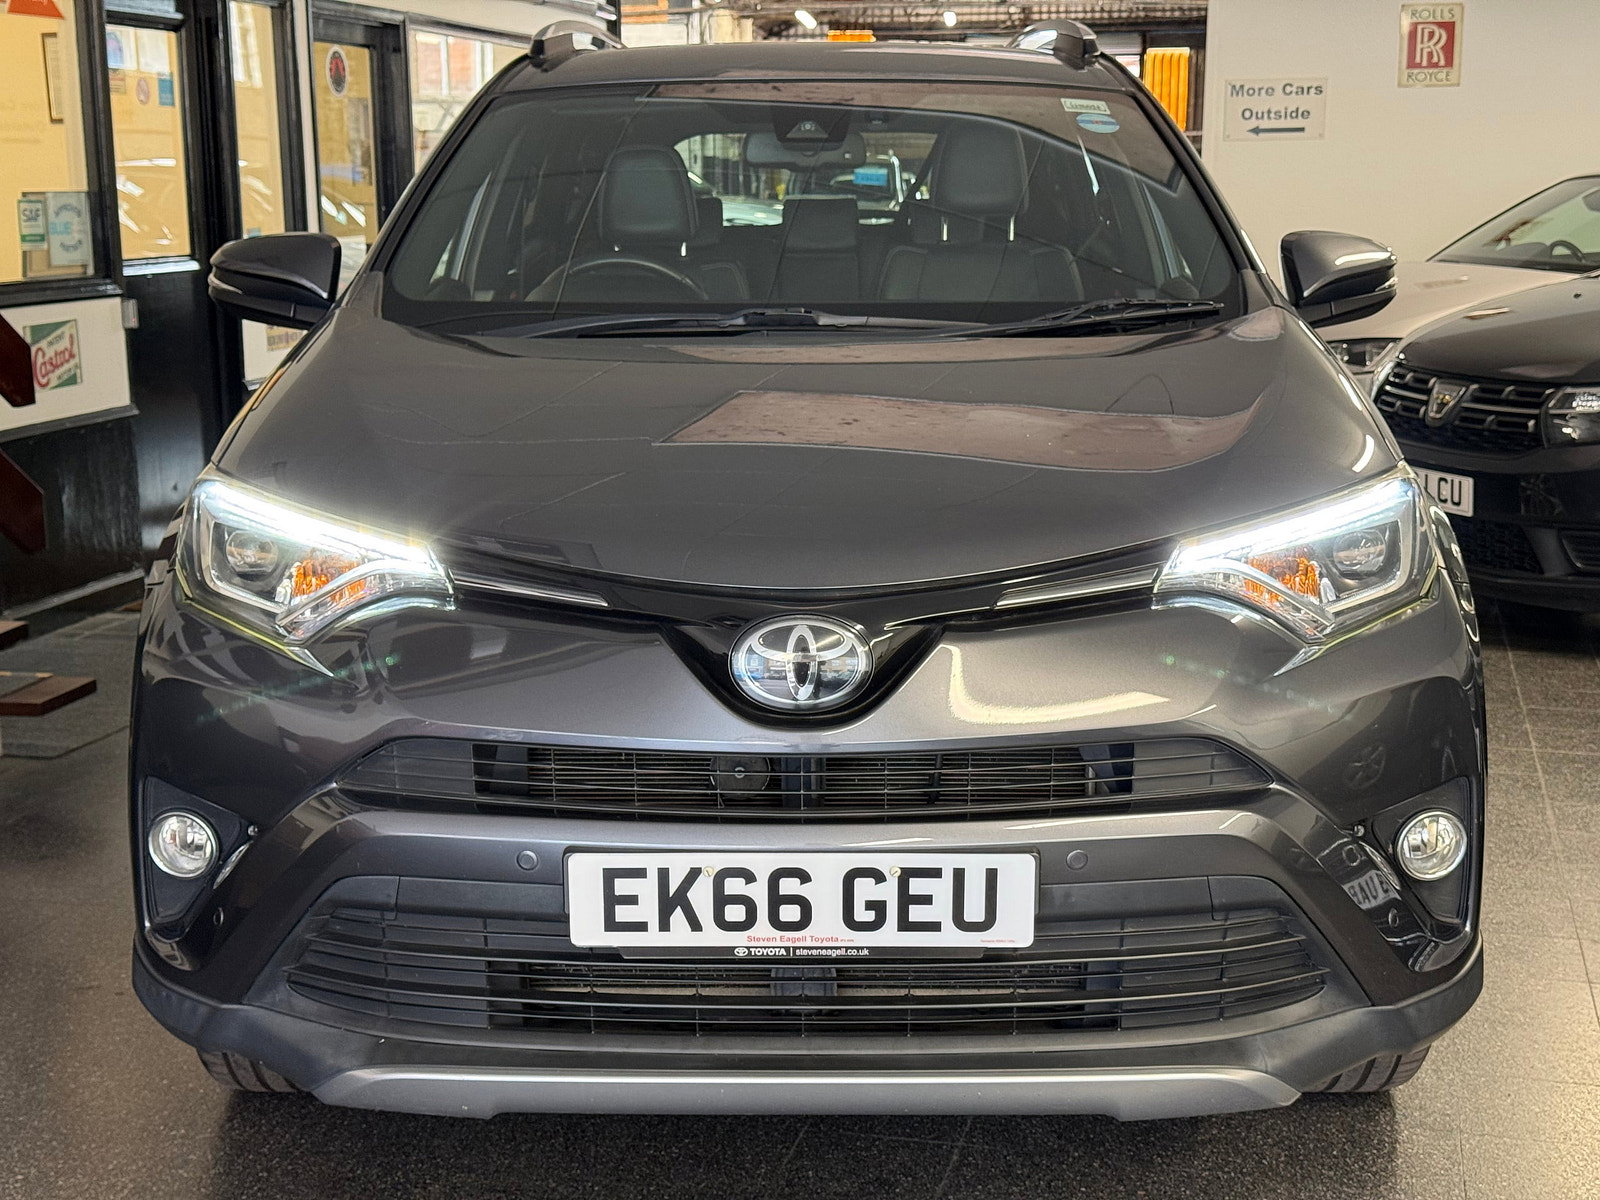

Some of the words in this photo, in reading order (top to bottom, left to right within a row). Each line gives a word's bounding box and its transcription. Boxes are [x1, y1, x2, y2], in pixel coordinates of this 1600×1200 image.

[1410, 8, 1455, 20] ROLLS
[1407, 70, 1451, 83] ROYCE
[1230, 84, 1275, 98] More
[1282, 82, 1323, 97] Cars
[1241, 106, 1311, 121] Outside
[33, 333, 77, 388] Castrol
[602, 867, 813, 932] EK66
[842, 867, 998, 932] GEU
[746, 935, 777, 943] Steven
[779, 935, 807, 944] Eagell
[809, 935, 839, 944] Toyota
[750, 947, 787, 956] TOYOTA
[795, 947, 869, 957] steveneagell.co.uk
